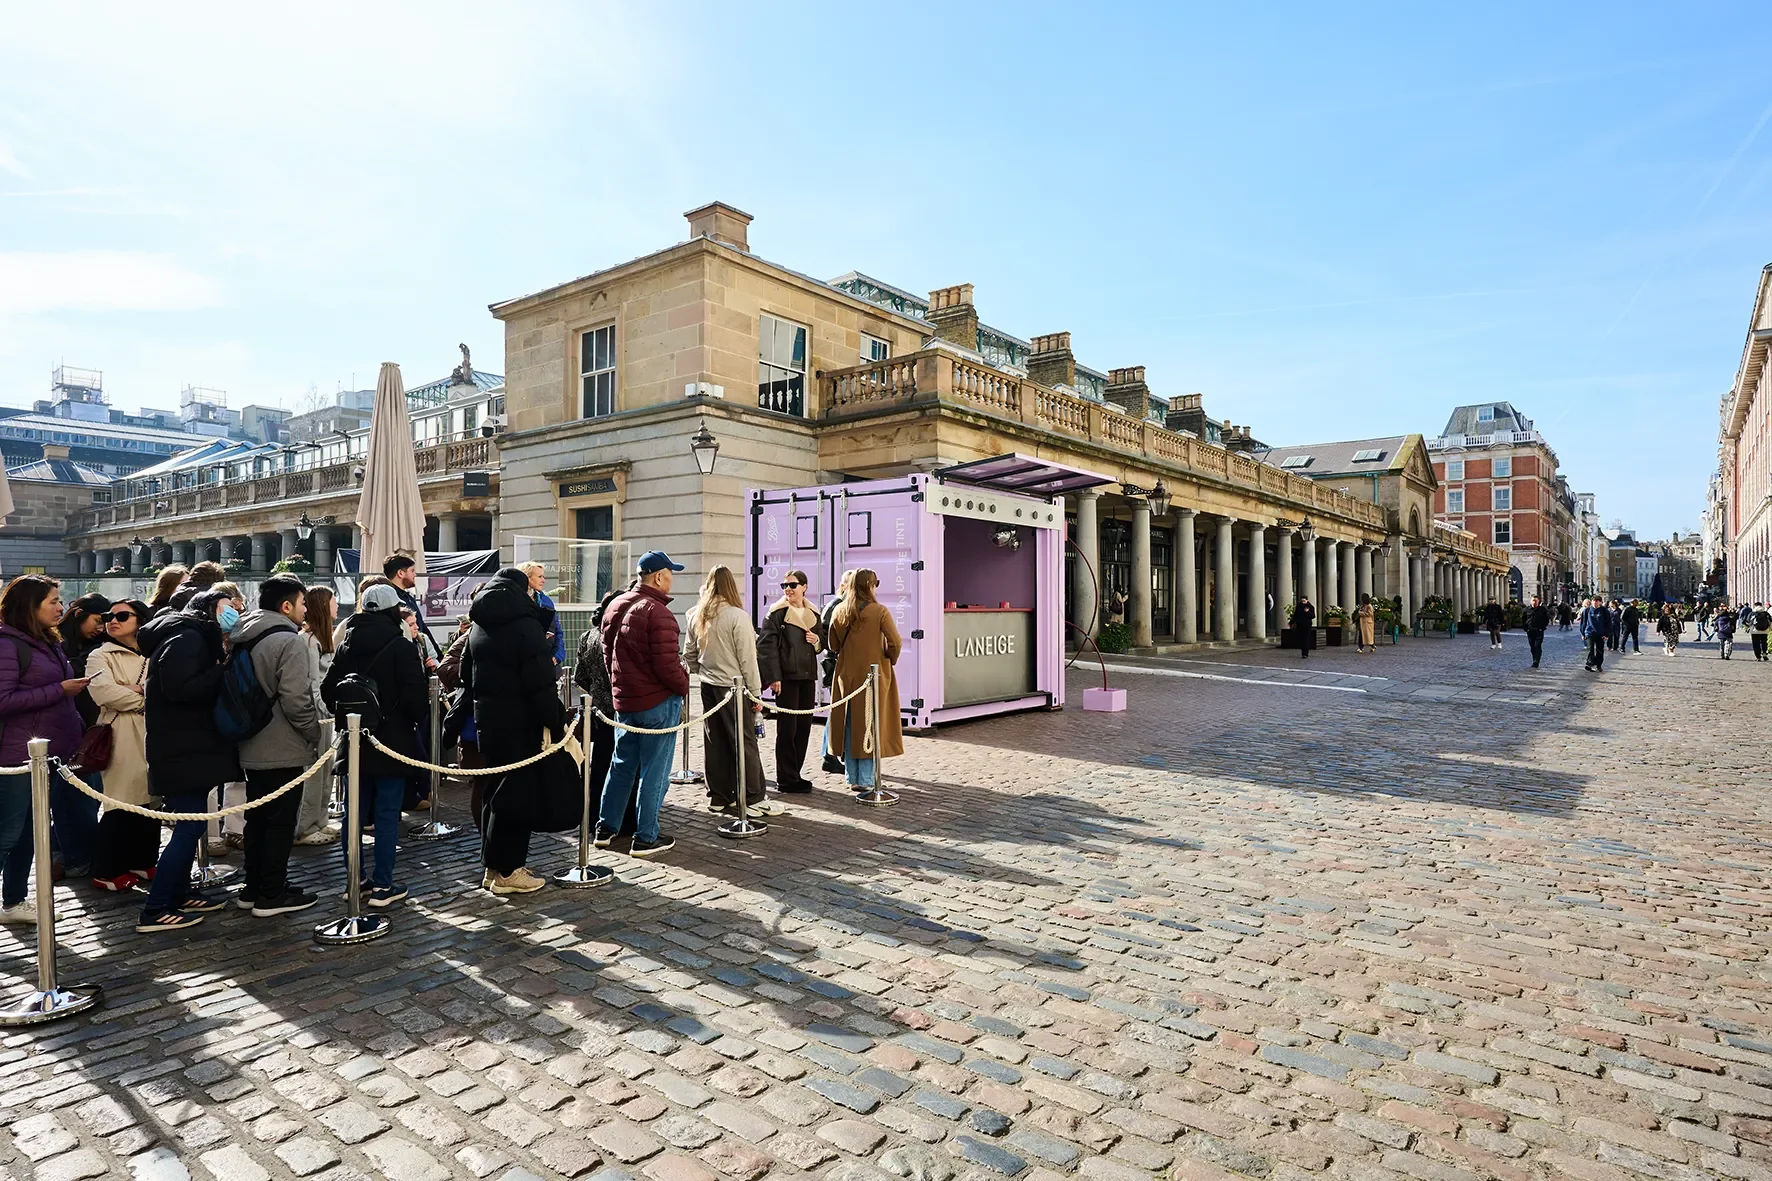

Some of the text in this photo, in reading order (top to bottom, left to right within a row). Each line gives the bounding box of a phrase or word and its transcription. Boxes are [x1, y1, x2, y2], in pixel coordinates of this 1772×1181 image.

[896, 517, 907, 627] TURN UP THE TINT!
[956, 634, 1015, 657] LANEIGE
